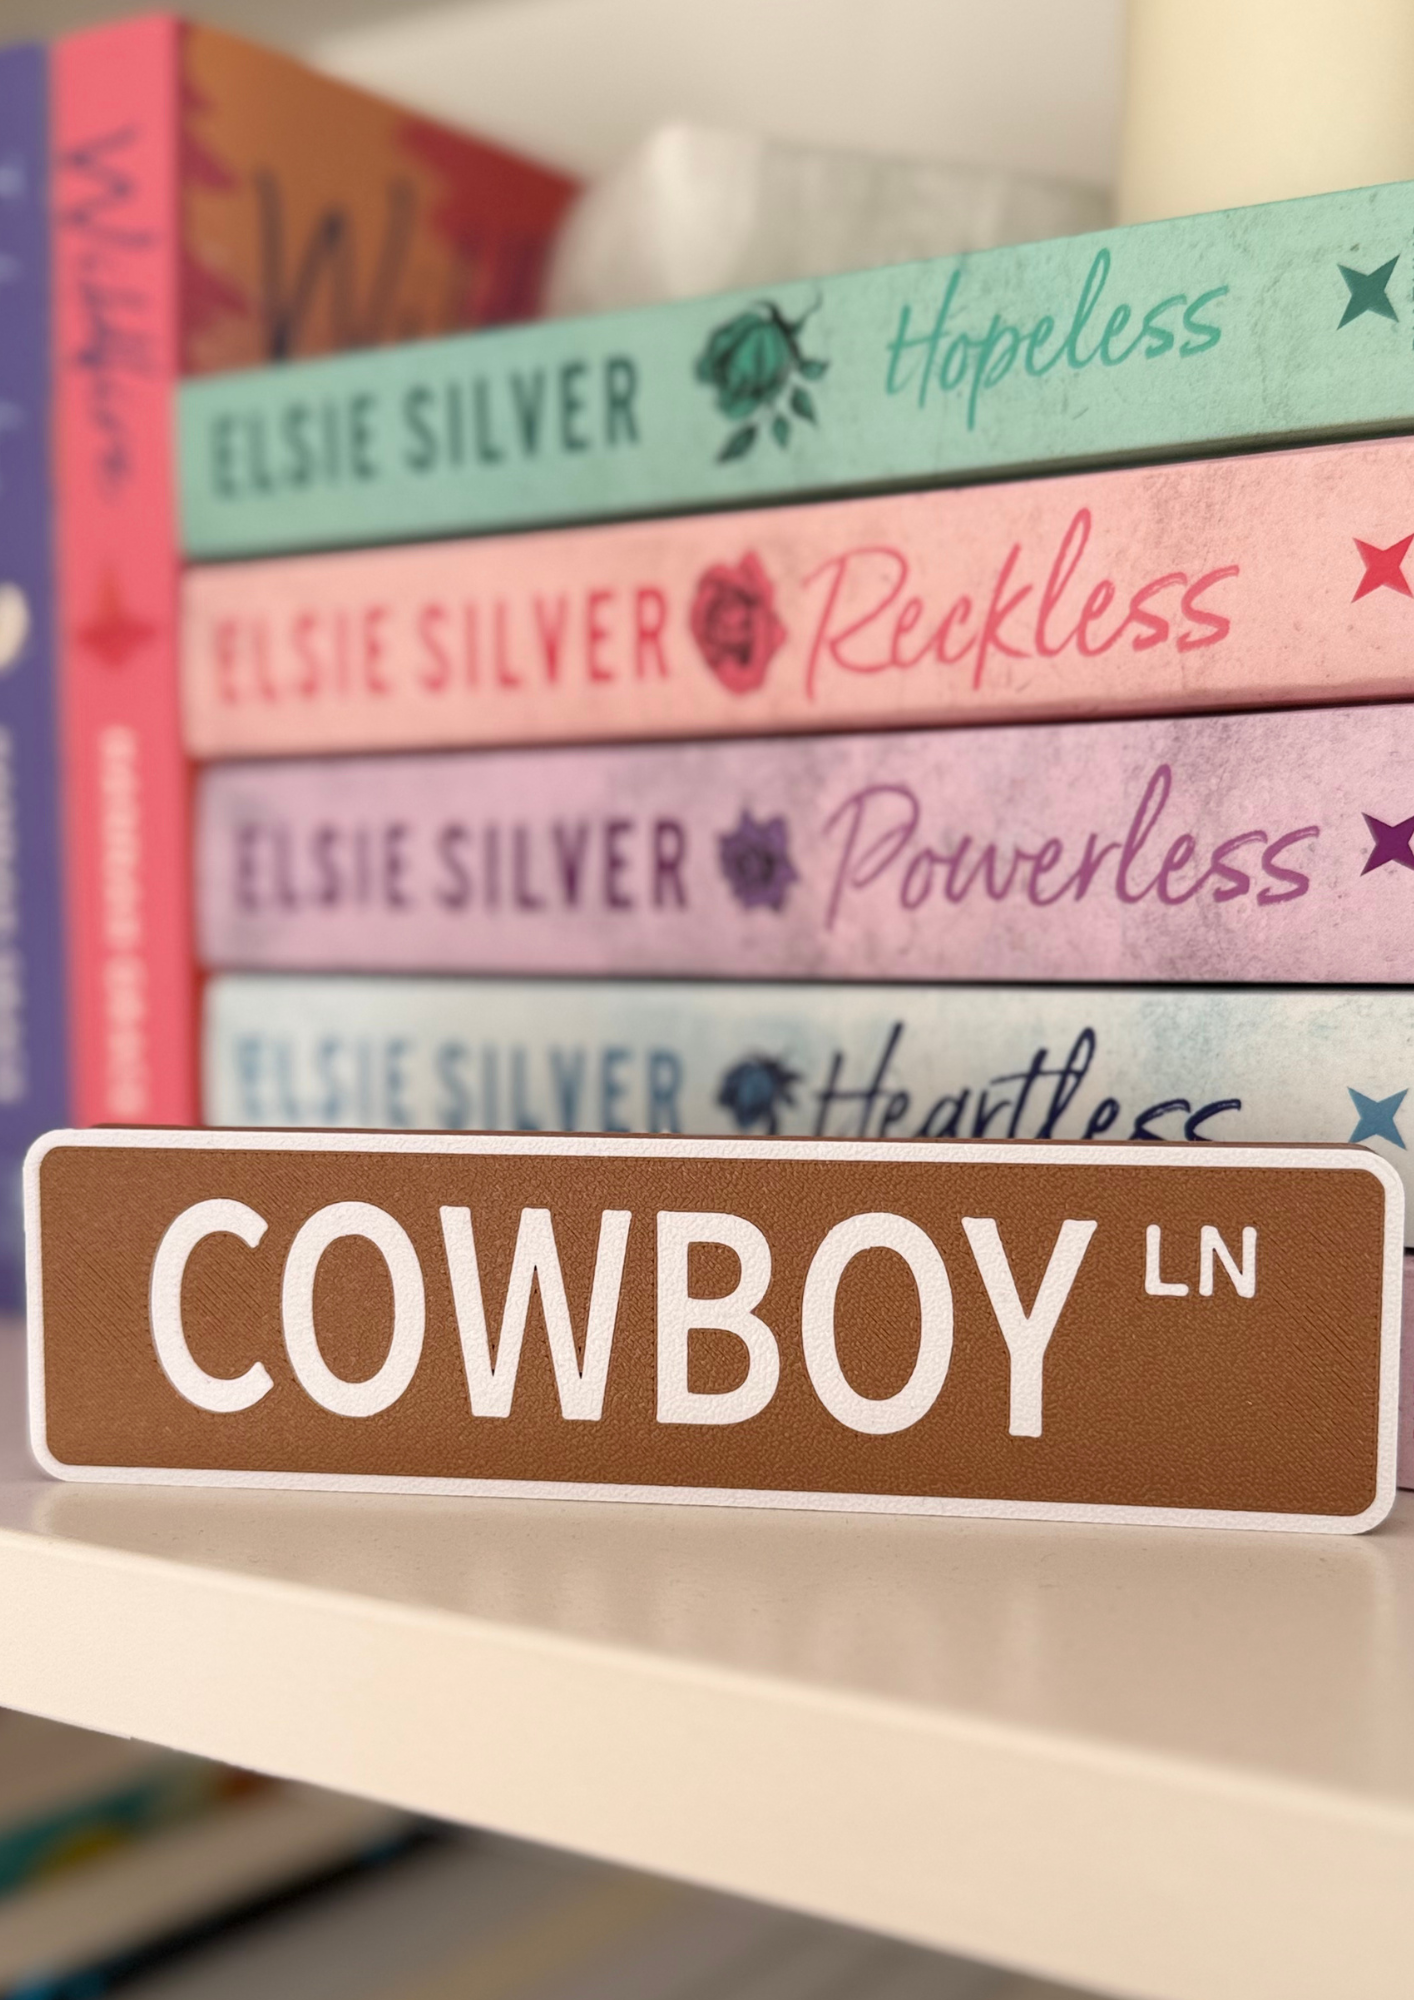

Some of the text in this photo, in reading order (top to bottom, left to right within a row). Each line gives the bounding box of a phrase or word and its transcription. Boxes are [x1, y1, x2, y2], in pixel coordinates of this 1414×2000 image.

[210, 248, 1229, 500] ELSIE SILVER Hopeless
[212, 508, 1240, 706] ELSIE SILVER Reckless
[233, 763, 1320, 932] ELSIE SILVER Powerless
[233, 1036, 415, 1128] ELSIE
[434, 1038, 684, 1133] SILVER
[150, 1198, 1258, 1438] COWBOY LN
